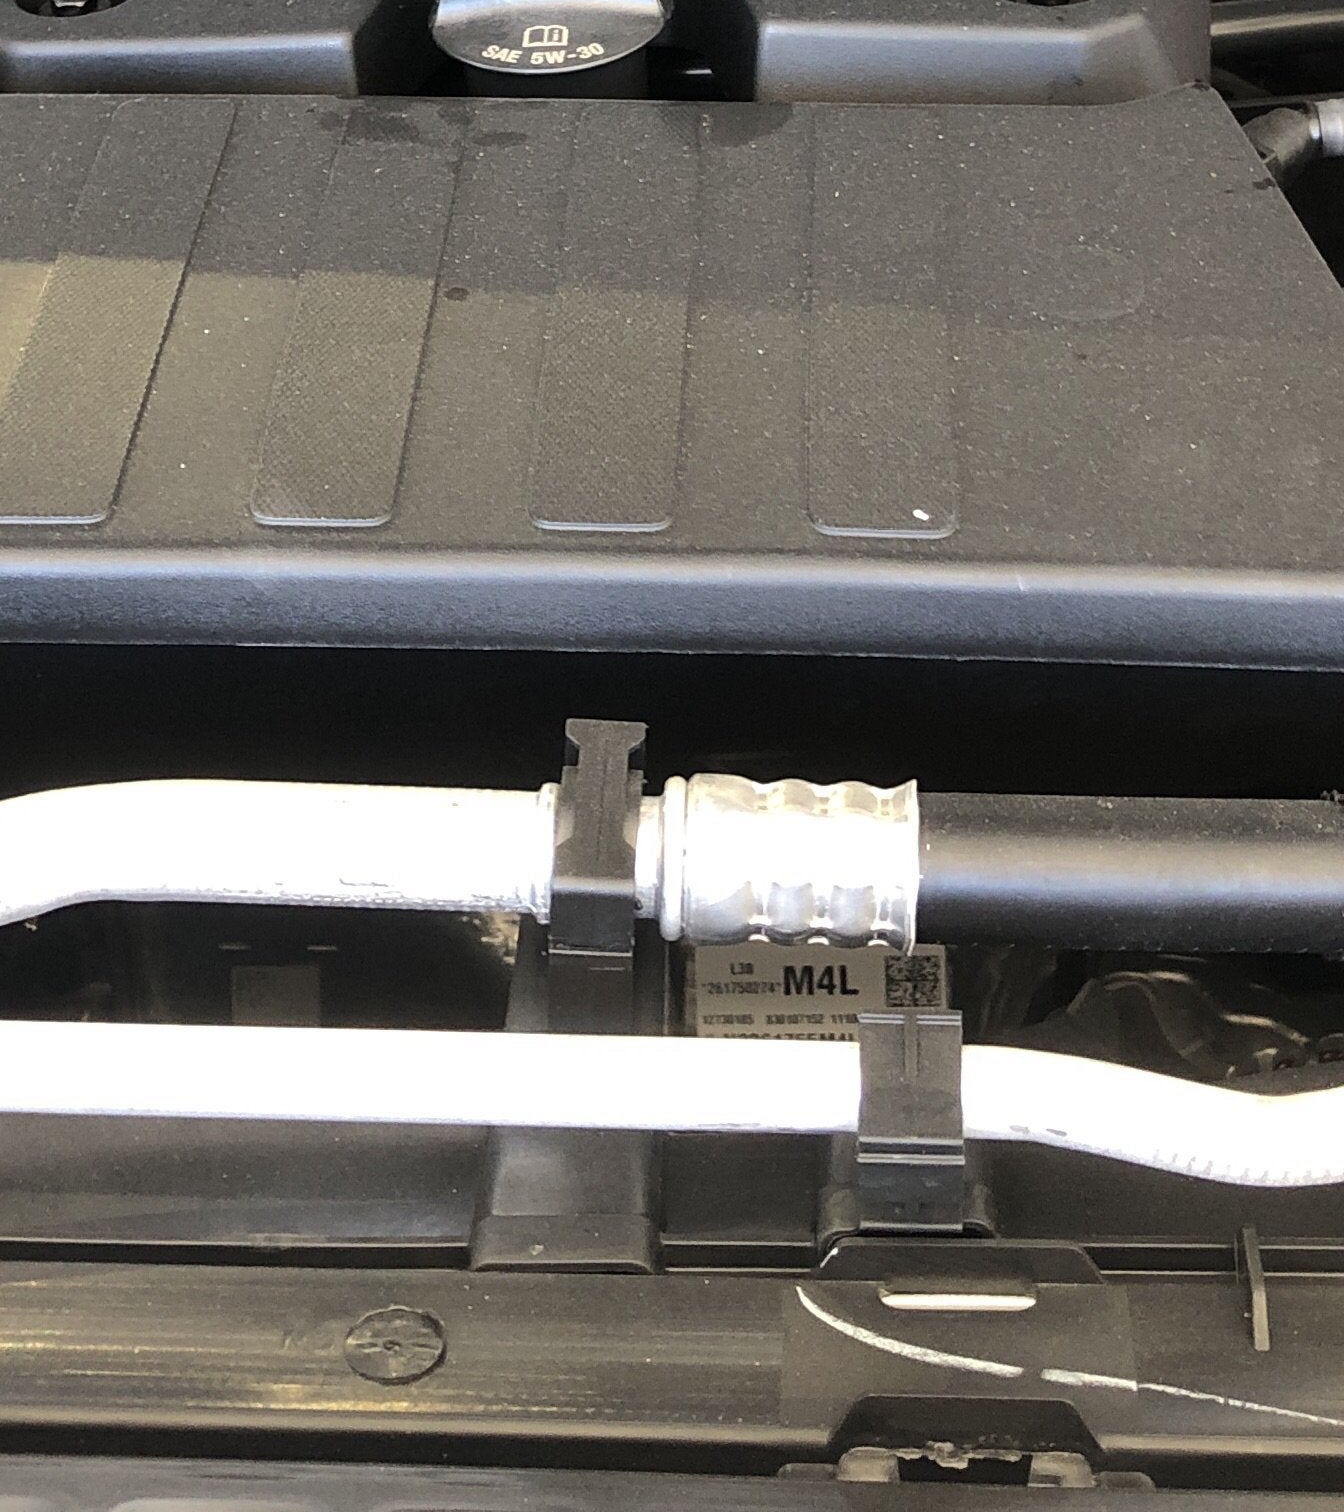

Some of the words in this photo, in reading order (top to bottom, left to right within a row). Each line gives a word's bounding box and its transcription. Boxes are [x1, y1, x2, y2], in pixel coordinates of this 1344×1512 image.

[481, 45, 522, 63] SAE
[530, 42, 605, 65] 5W-30
[783, 965, 860, 996] M4L
